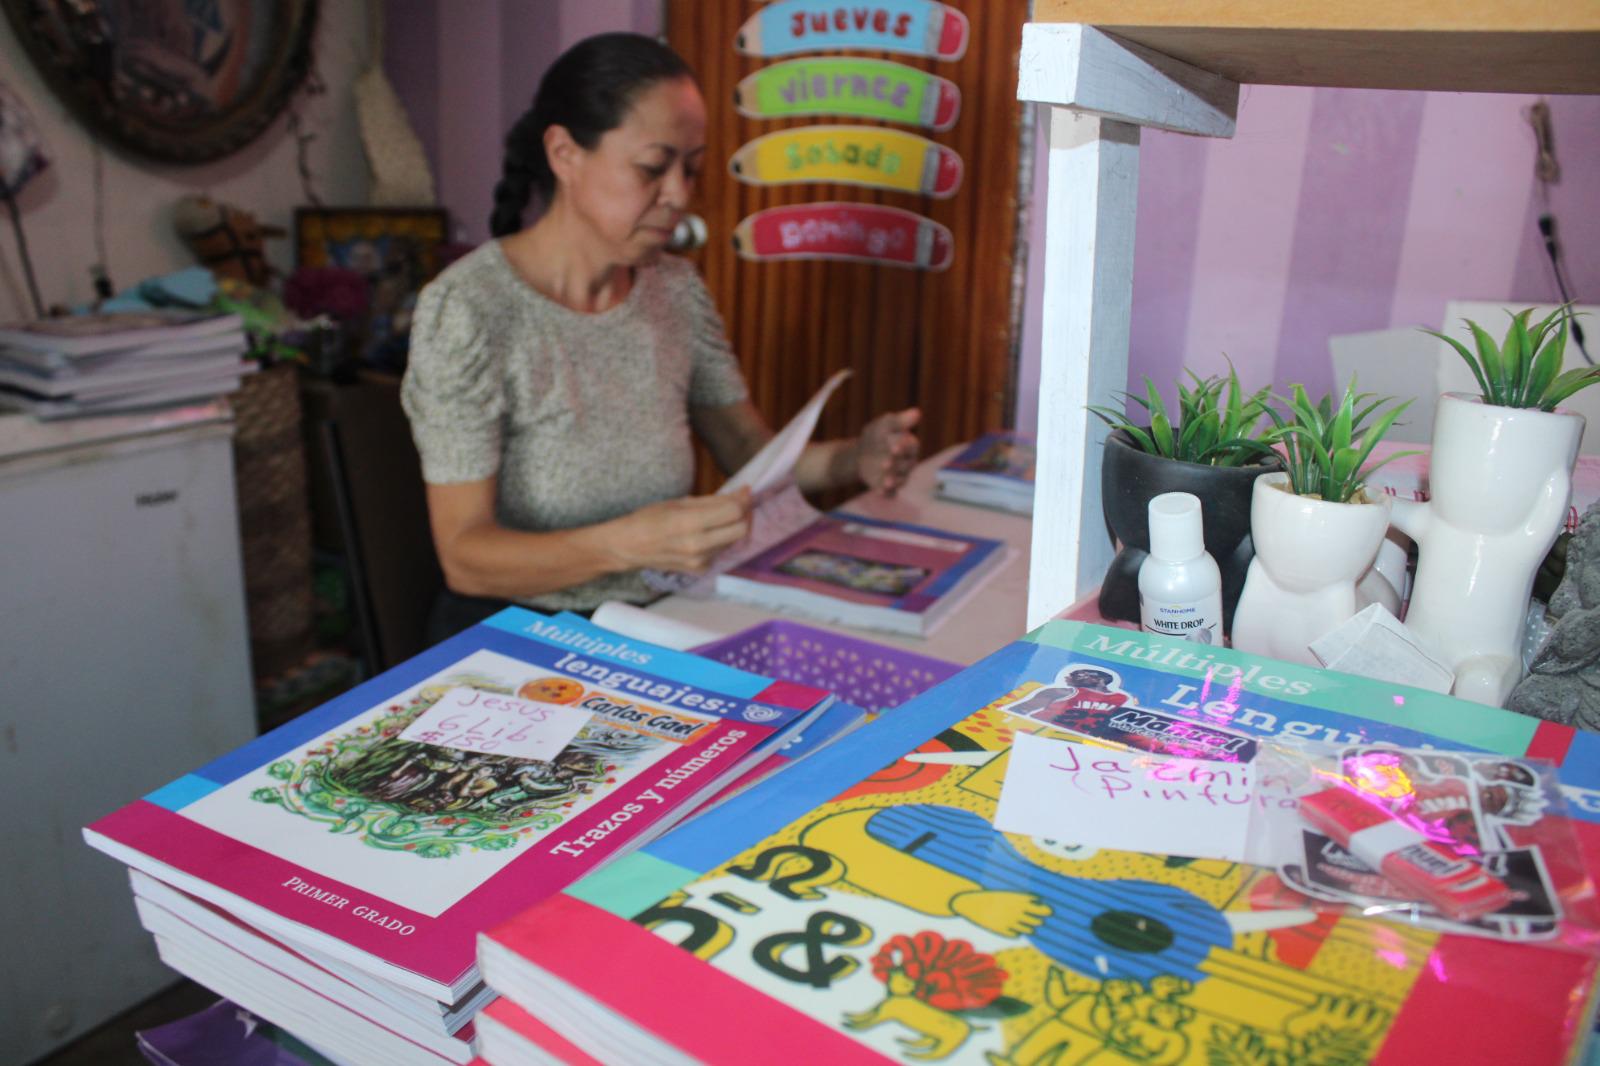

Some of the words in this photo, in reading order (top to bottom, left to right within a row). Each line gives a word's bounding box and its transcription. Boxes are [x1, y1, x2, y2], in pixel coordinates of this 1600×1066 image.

[524, 619, 653, 666] Múltiples
[1153, 618, 1180, 630] WHITE
[1180, 618, 1204, 630] DROP
[554, 652, 738, 714] lenguajes:
[1083, 634, 1314, 696] Múltiples
[437, 714, 469, 731] 6
[581, 697, 646, 724] Carlos
[646, 715, 703, 738] Gael
[550, 802, 645, 858] Trazos
[635, 788, 665, 804] y
[654, 729, 748, 790] números
[281, 876, 350, 909] PRIMER
[351, 905, 417, 936] GRADO
